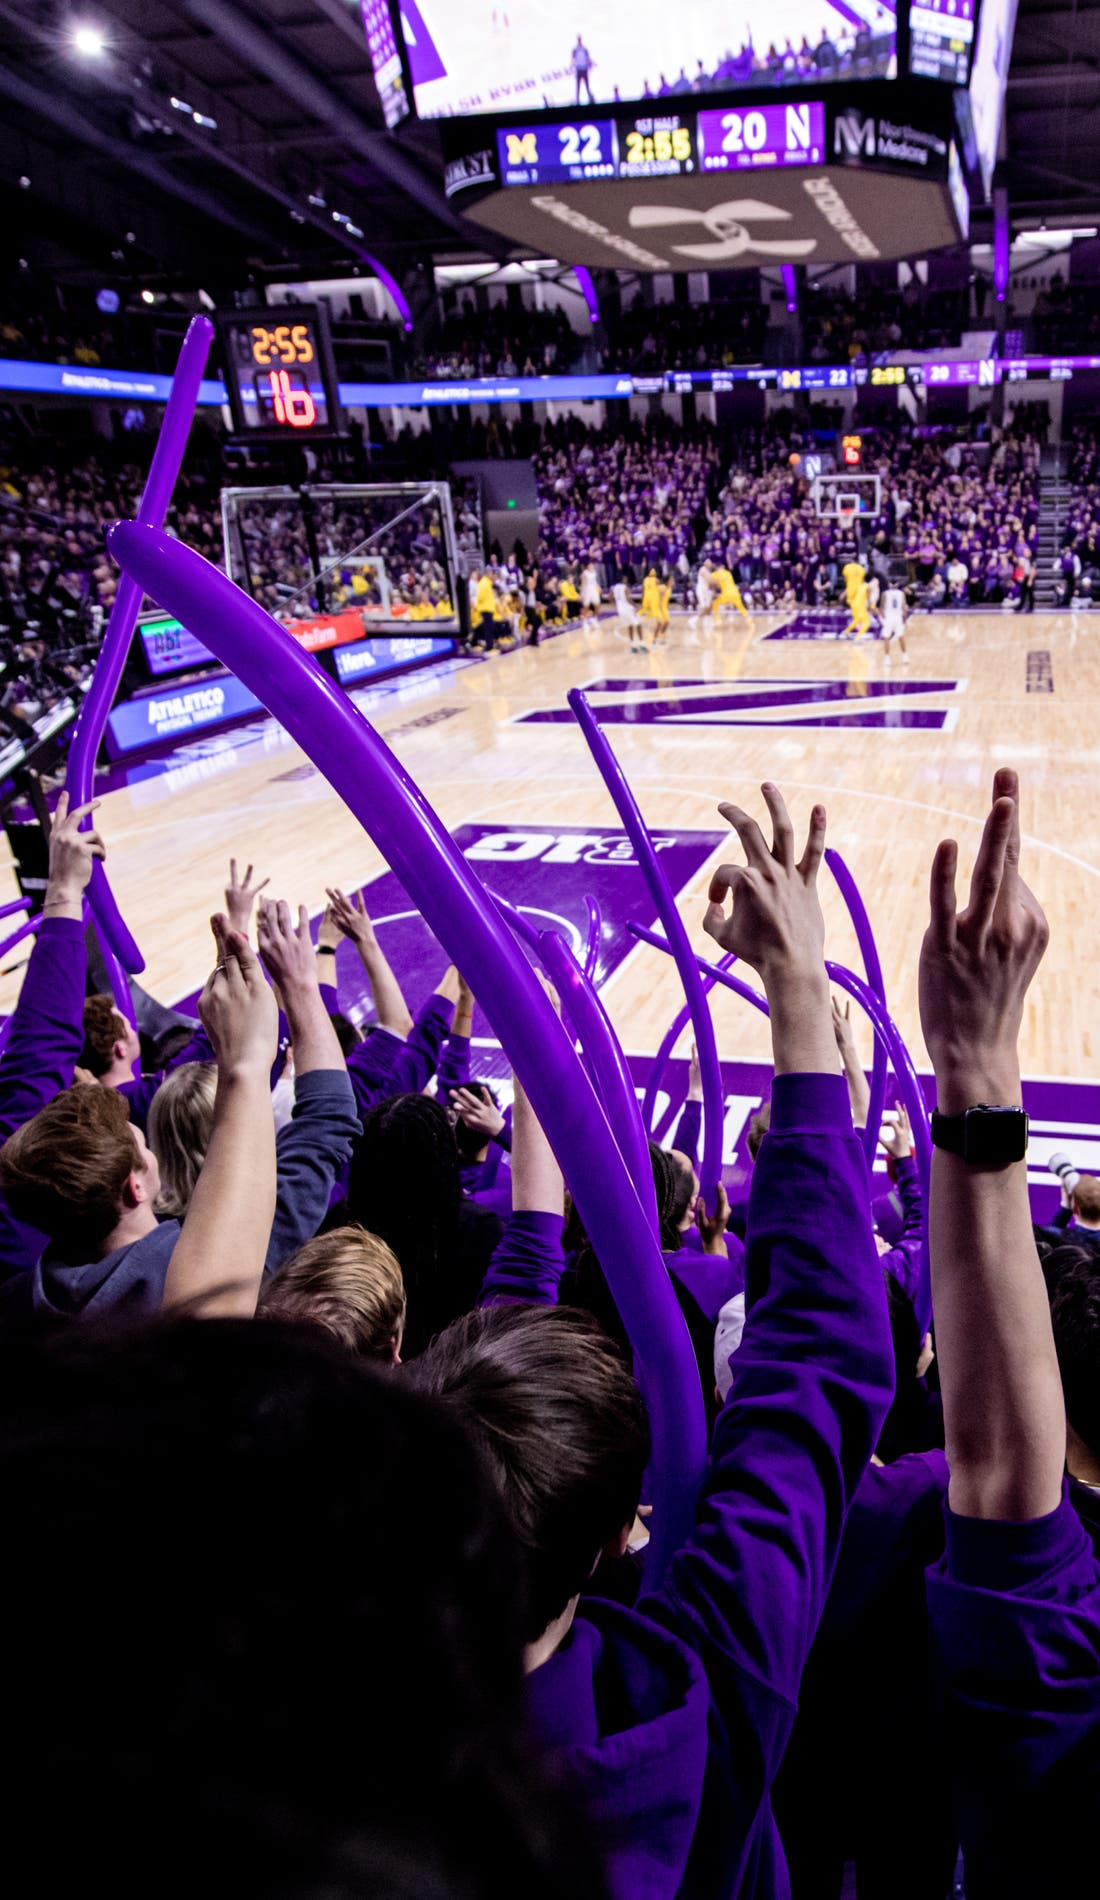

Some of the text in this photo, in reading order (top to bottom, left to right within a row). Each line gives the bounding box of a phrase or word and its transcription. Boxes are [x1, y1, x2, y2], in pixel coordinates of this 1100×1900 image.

[558, 125, 602, 165] 22
[721, 113, 767, 152] 20
[785, 104, 810, 150] N
[506, 133, 539, 165] M
[626, 128, 692, 164] 2:55
[252, 325, 314, 365] 2:55
[781, 369, 802, 390] M
[829, 368, 848, 387] 22
[870, 366, 906, 386] 2:55
[929, 365, 950, 382] 20
[978, 359, 995, 387] N
[269, 369, 316, 429] 16
[148, 687, 225, 726] ATHLETICO
